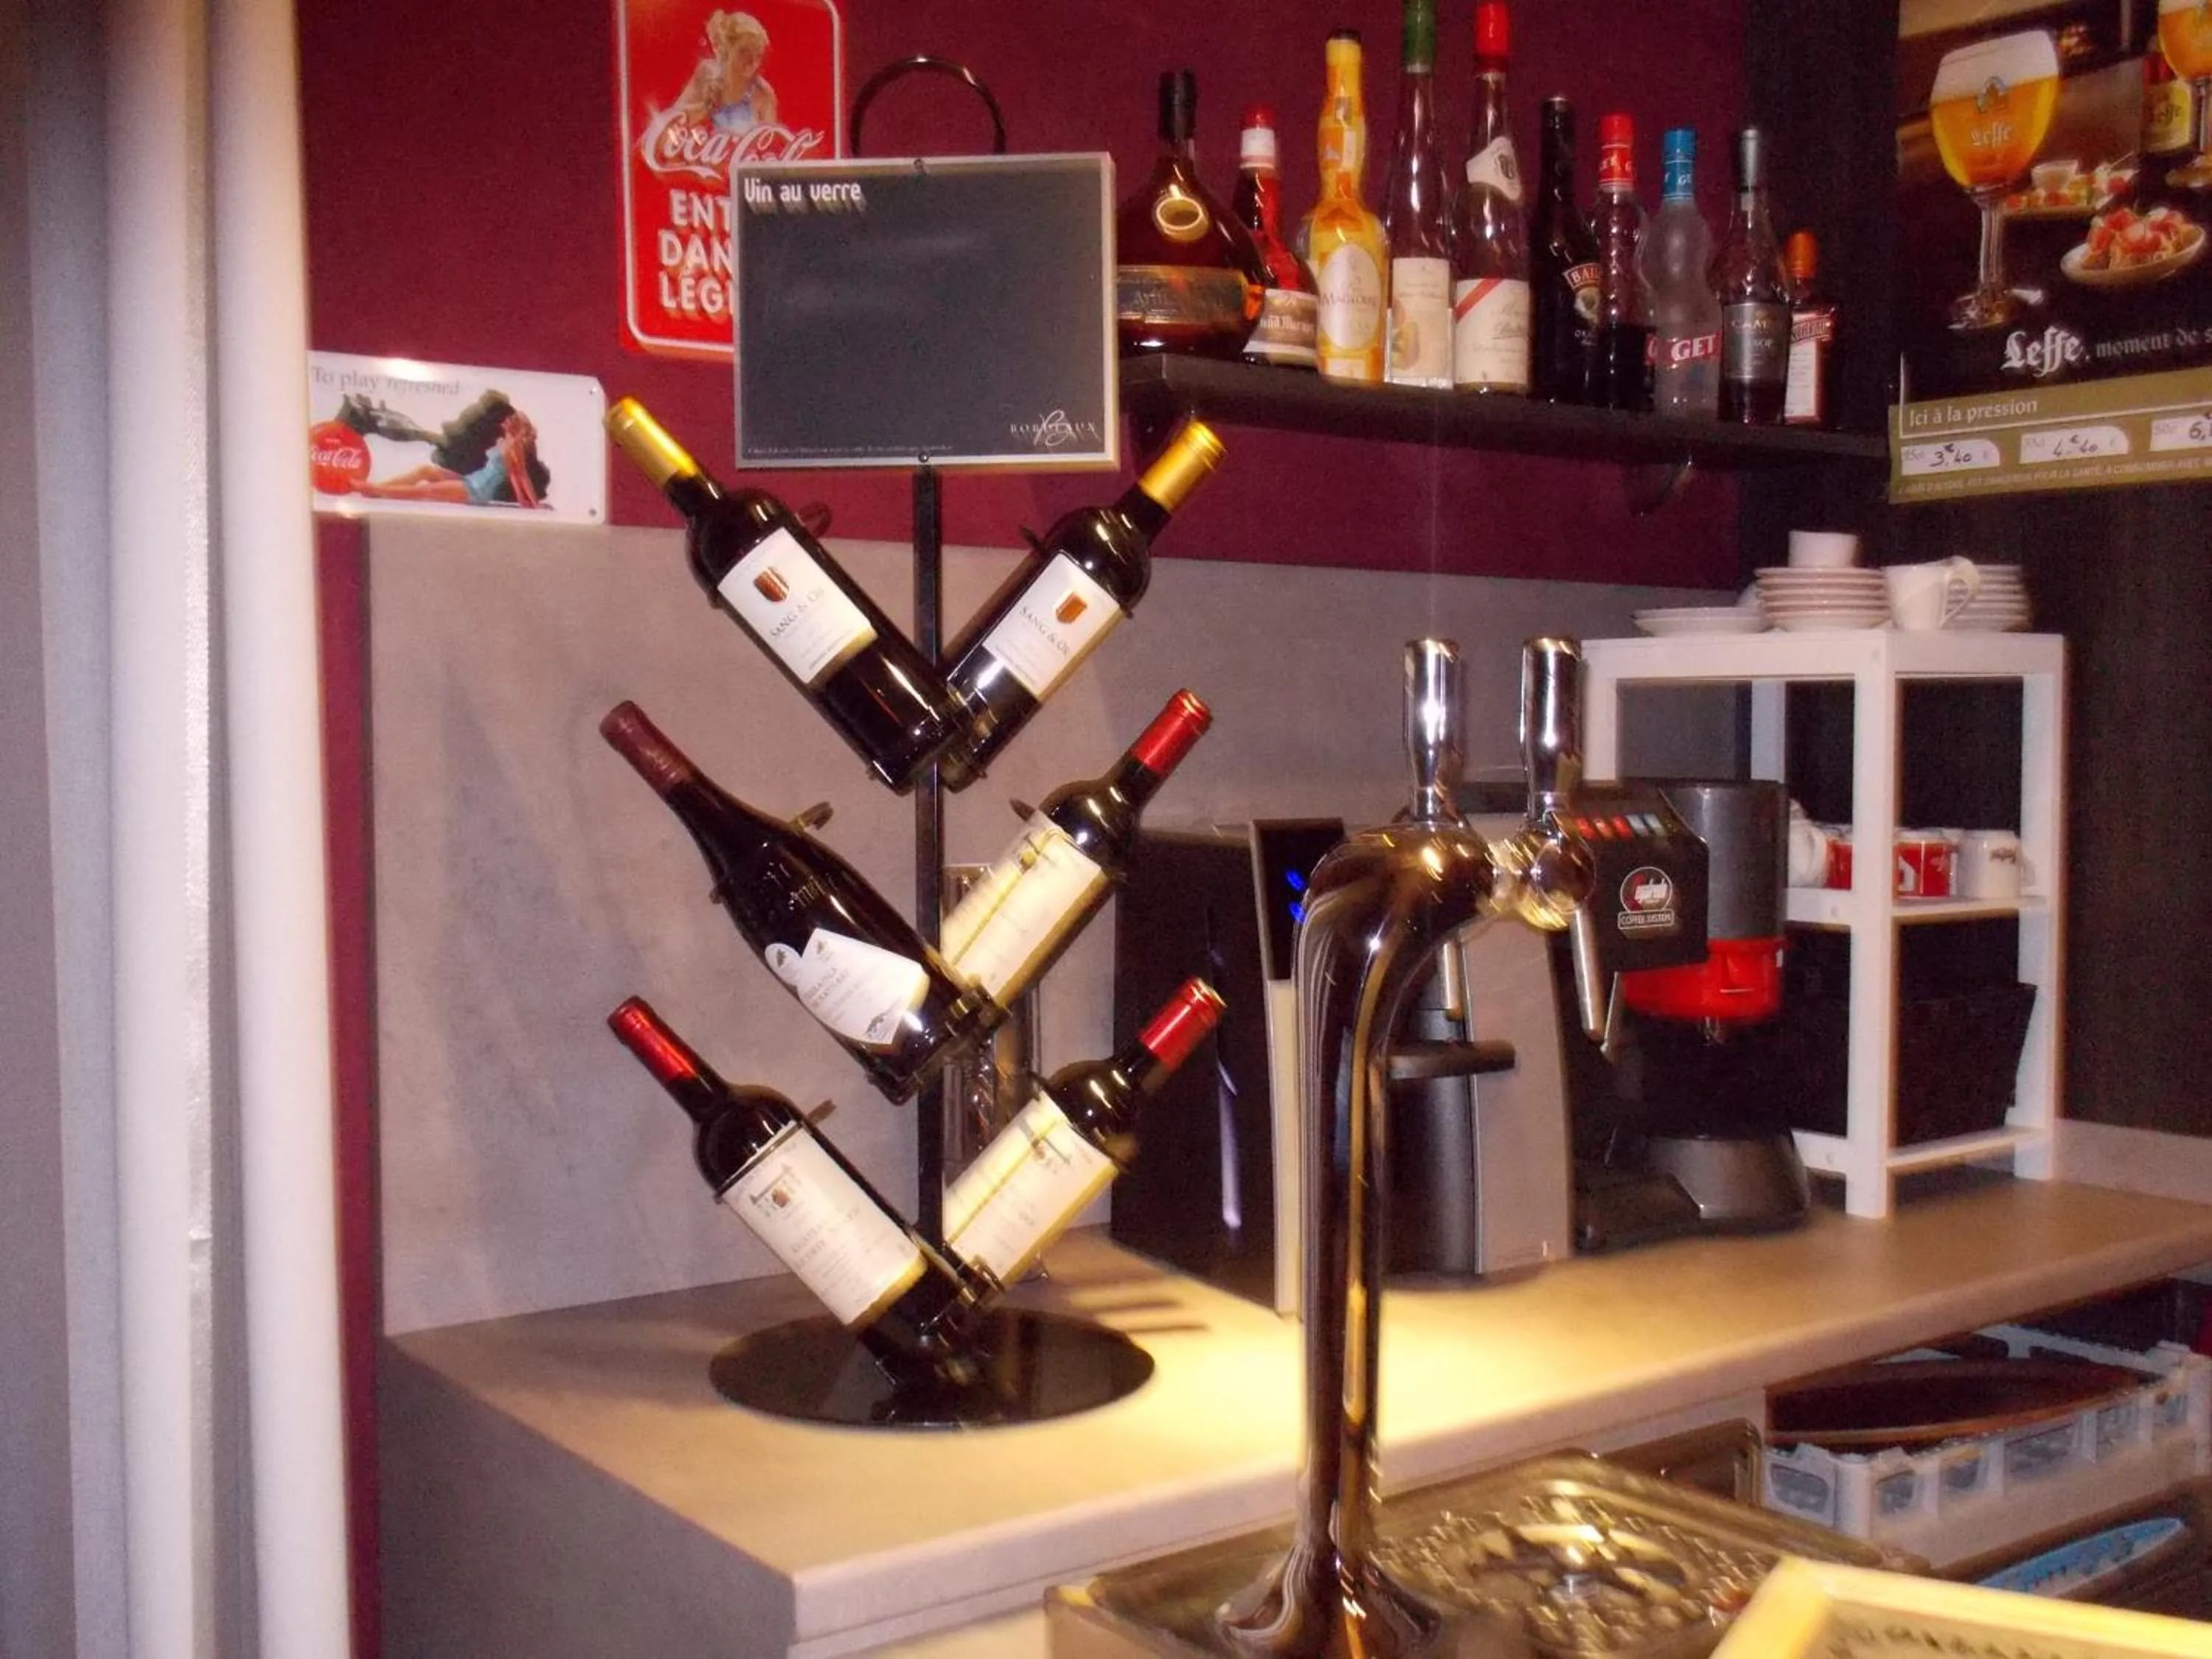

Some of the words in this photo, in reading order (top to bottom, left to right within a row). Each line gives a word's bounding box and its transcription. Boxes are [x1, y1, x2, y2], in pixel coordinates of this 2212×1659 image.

[744, 177, 773, 203] Vin
[780, 184, 801, 202] au
[810, 181, 862, 202] verre
[669, 188, 732, 232] ENT
[658, 229, 732, 276] DAN
[1670, 334, 1717, 361] GET
[2096, 332, 2171, 358] moment
[2177, 327, 2197, 346] de
[312, 366, 333, 384] To
[340, 371, 379, 393] play
[1909, 409, 1927, 427] Ici
[1933, 409, 1942, 424] à
[1947, 406, 1961, 422] la
[1967, 399, 2038, 424] pression
